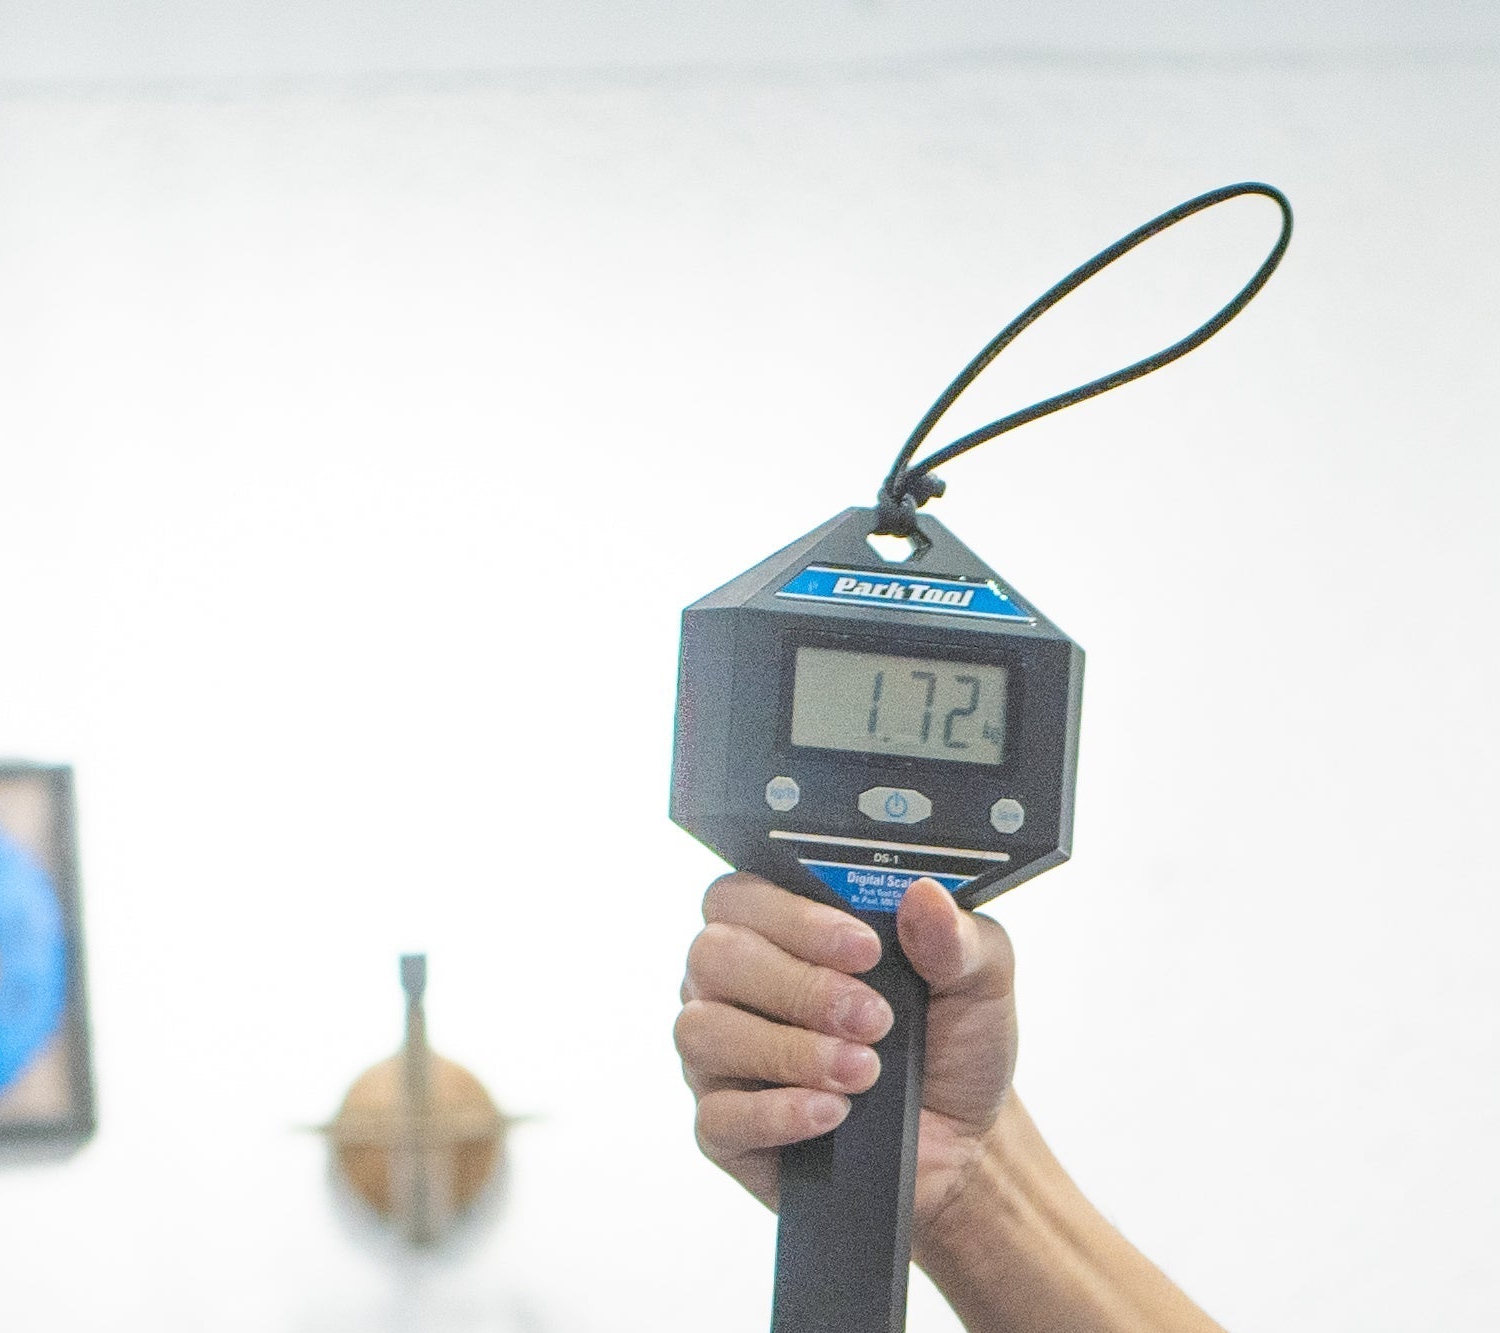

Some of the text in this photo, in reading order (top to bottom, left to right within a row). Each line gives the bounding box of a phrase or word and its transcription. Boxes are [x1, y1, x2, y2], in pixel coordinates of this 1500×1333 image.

[832, 576, 975, 607] Park Tool
[873, 852, 899, 864] DS-1
[847, 871, 913, 889] Digital Scal
